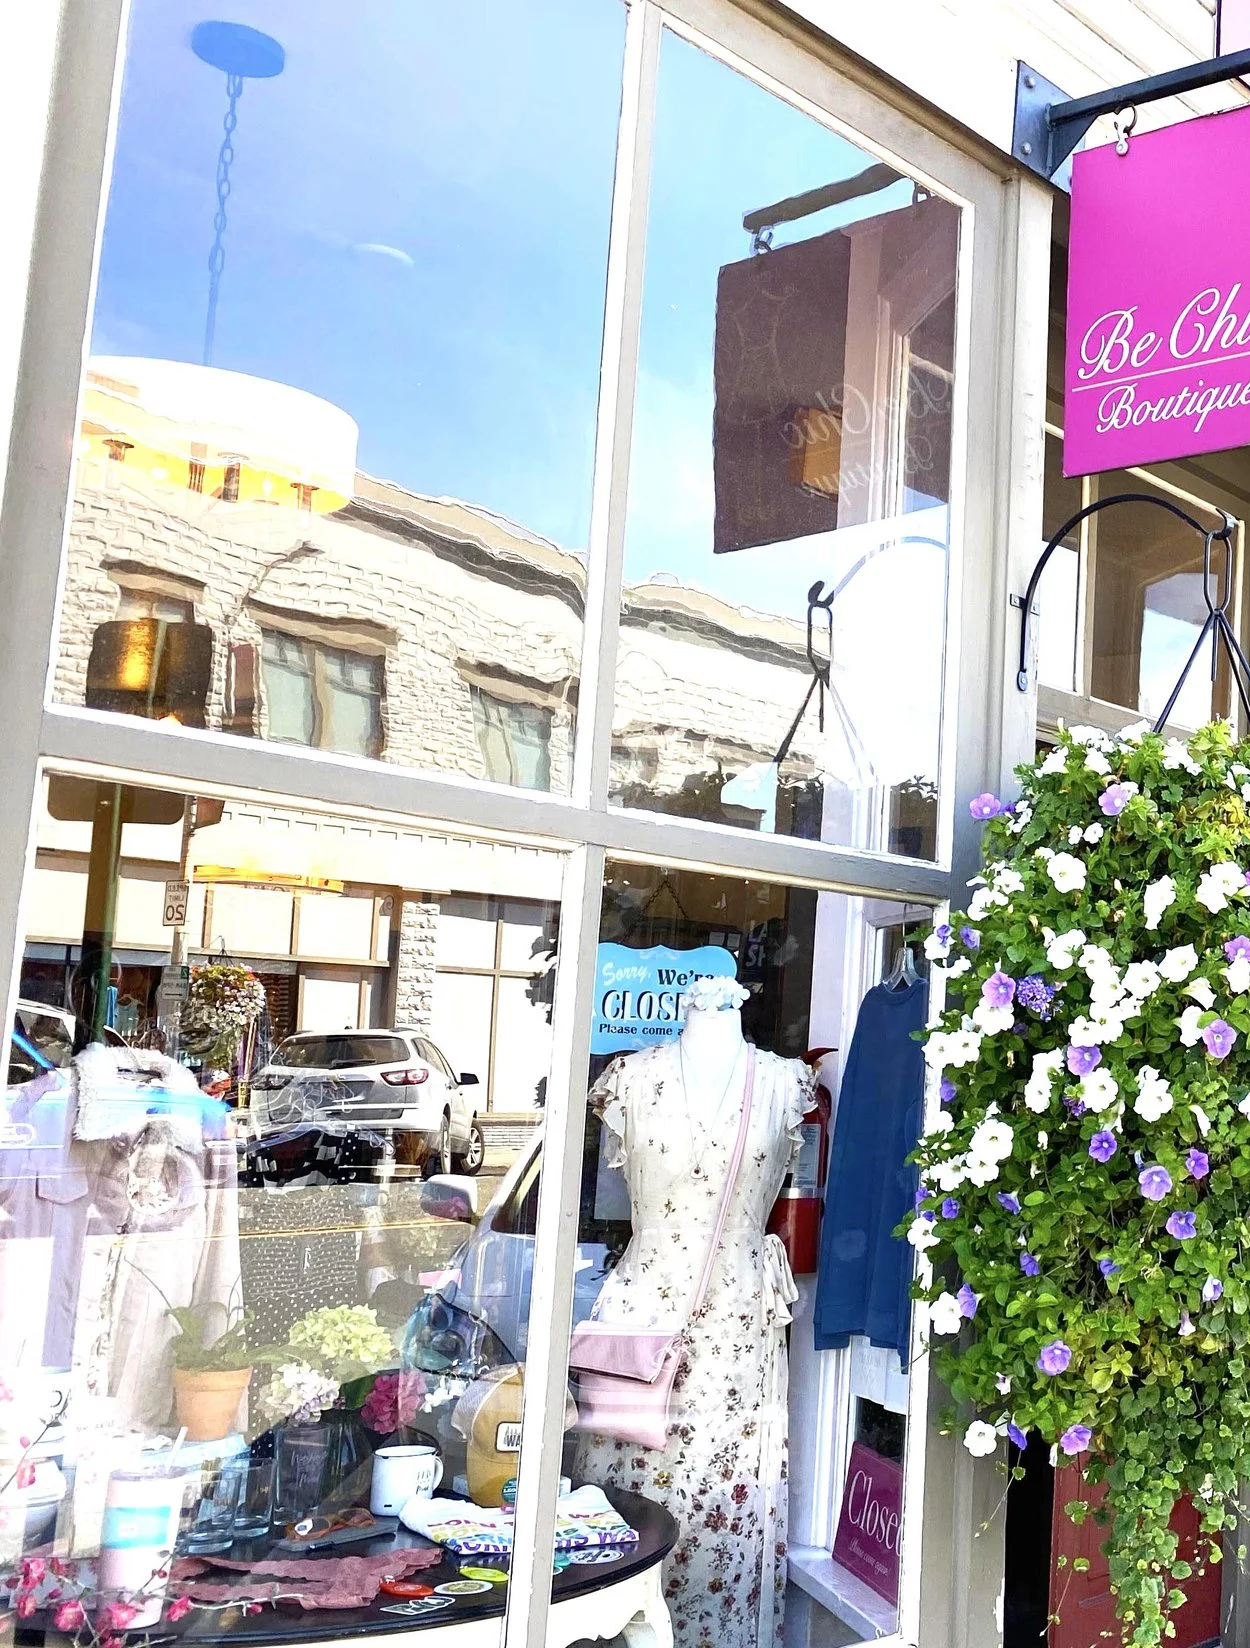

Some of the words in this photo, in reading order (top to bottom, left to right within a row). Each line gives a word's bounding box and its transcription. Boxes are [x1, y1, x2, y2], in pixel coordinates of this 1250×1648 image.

[1077, 304, 1162, 380] Be
[602, 989, 685, 1023] CLOS
[599, 1023, 637, 1034] Please
[642, 1026, 673, 1036] come
